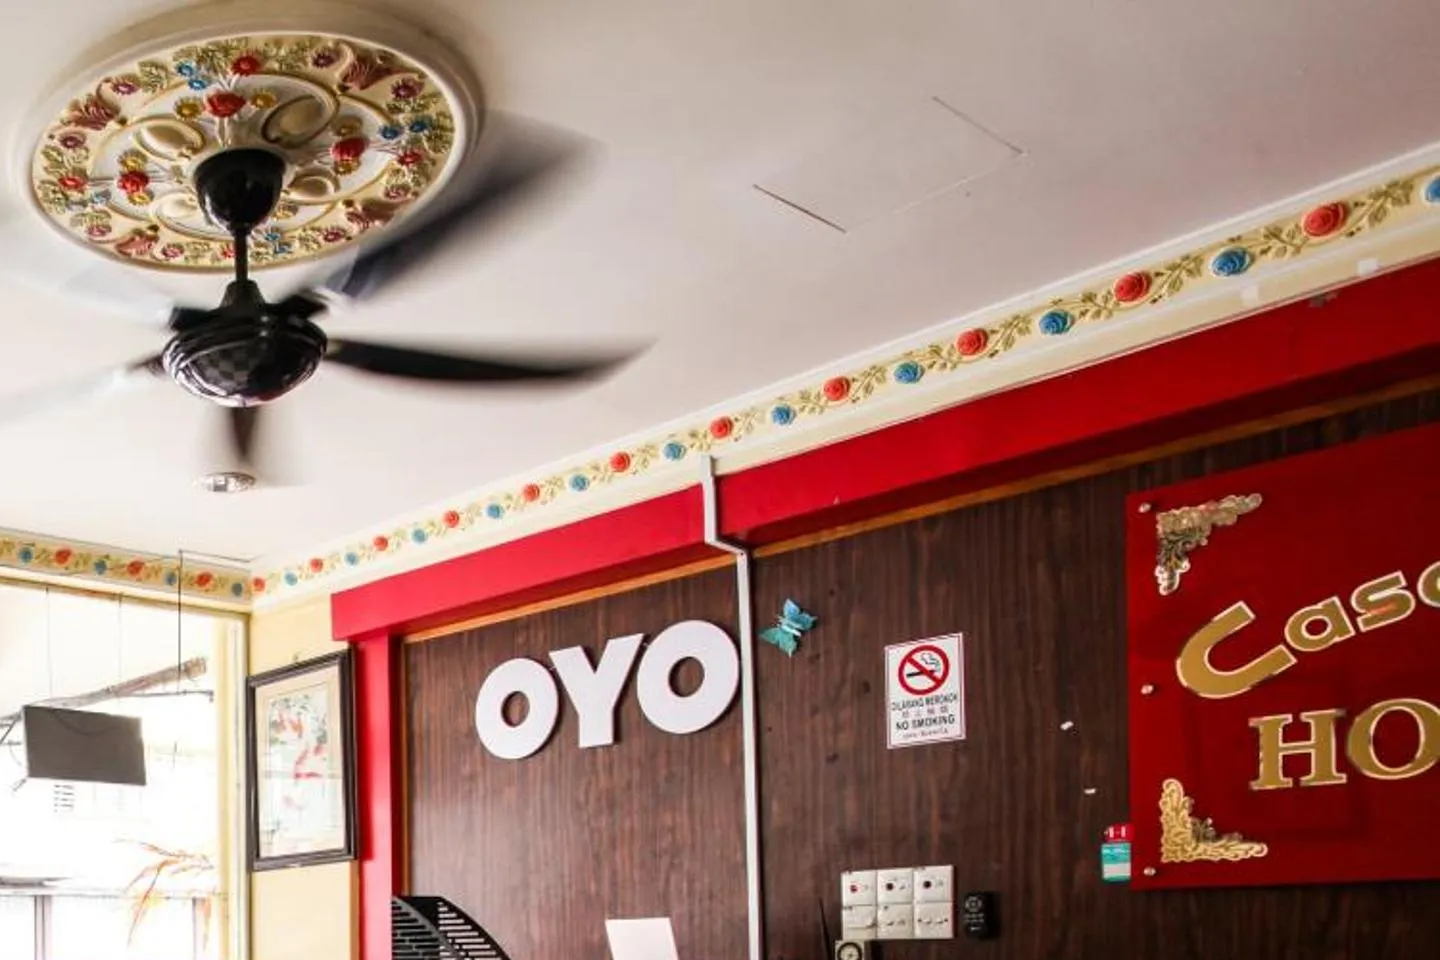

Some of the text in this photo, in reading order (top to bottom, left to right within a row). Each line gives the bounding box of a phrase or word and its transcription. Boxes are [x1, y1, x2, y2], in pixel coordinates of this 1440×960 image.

[475, 619, 740, 760] OYO
[896, 713, 956, 730] NO SMOKING
